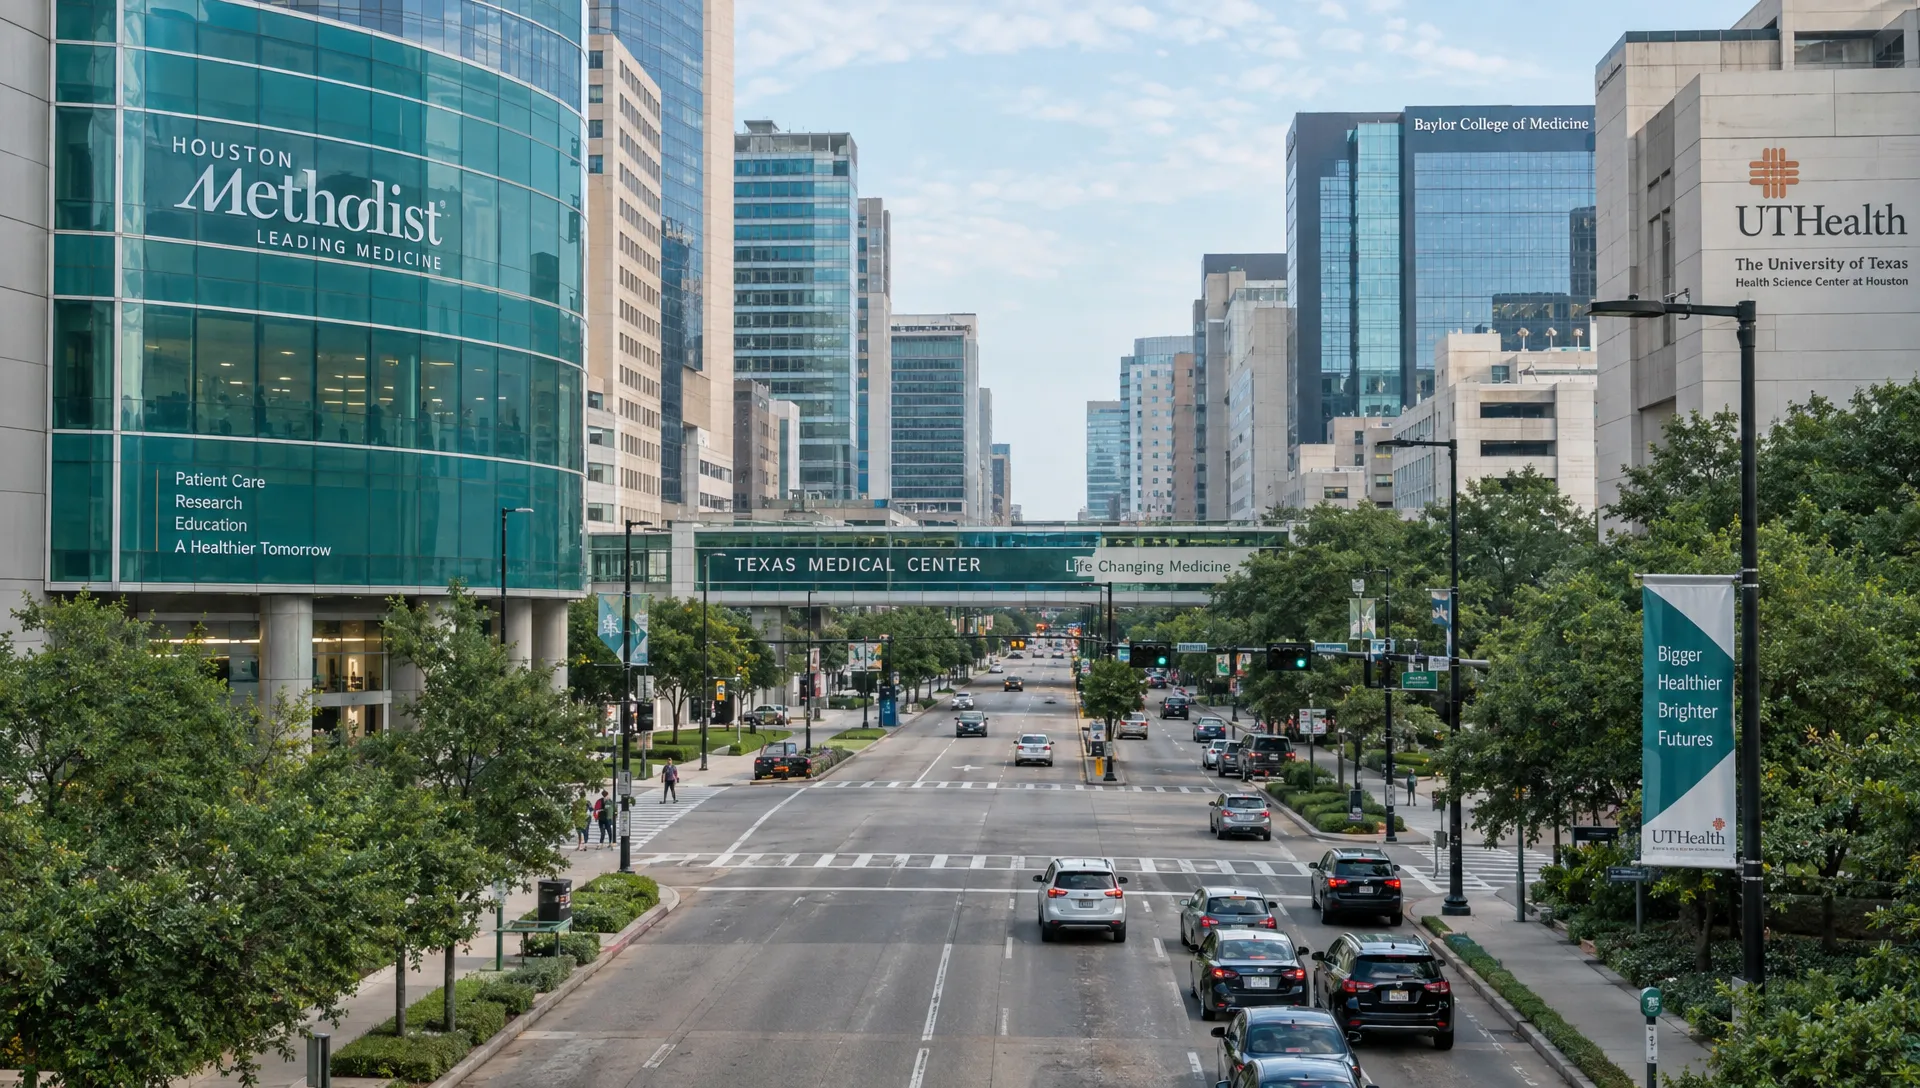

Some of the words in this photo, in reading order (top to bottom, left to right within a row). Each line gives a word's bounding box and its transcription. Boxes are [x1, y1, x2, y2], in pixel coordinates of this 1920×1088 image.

[1414, 117, 1457, 134] Baylor
[1460, 118, 1509, 133] College
[1512, 118, 1527, 130] of
[1529, 118, 1589, 130] Medicine
[172, 136, 292, 168] HOUSTON
[173, 164, 443, 246] Methodist
[1735, 202, 1908, 237] UTHealth
[257, 229, 346, 254] LEADING
[357, 243, 441, 270] MEDICINE
[1735, 258, 1763, 271] The
[1768, 257, 1845, 273] University
[1849, 256, 1865, 270] of
[1867, 257, 1909, 270] Texas
[1735, 277, 1770, 288] Health
[1773, 277, 1813, 288] Science
[1815, 277, 1850, 287] Center
[1852, 278, 1863, 286] at
[1866, 276, 1909, 287] Houston
[175, 471, 228, 488] Patient
[232, 474, 266, 489] Care
[175, 494, 243, 510] Research
[175, 516, 248, 532] Education
[174, 539, 187, 554] A
[191, 540, 256, 555] Healthier
[260, 541, 332, 556] Tomorrow
[734, 557, 796, 572] TEXAS
[808, 557, 896, 572] MEDICAL
[907, 557, 981, 572] CENTER
[1065, 559, 1093, 573] Life
[1098, 559, 1164, 576] Changing
[1169, 560, 1231, 573] Medicine
[1658, 645, 1703, 666] Bigger
[1658, 674, 1723, 691] Healthier
[1658, 702, 1719, 723] Brighter
[1658, 730, 1714, 747] Futures
[1652, 829, 1726, 845] UTHealth
